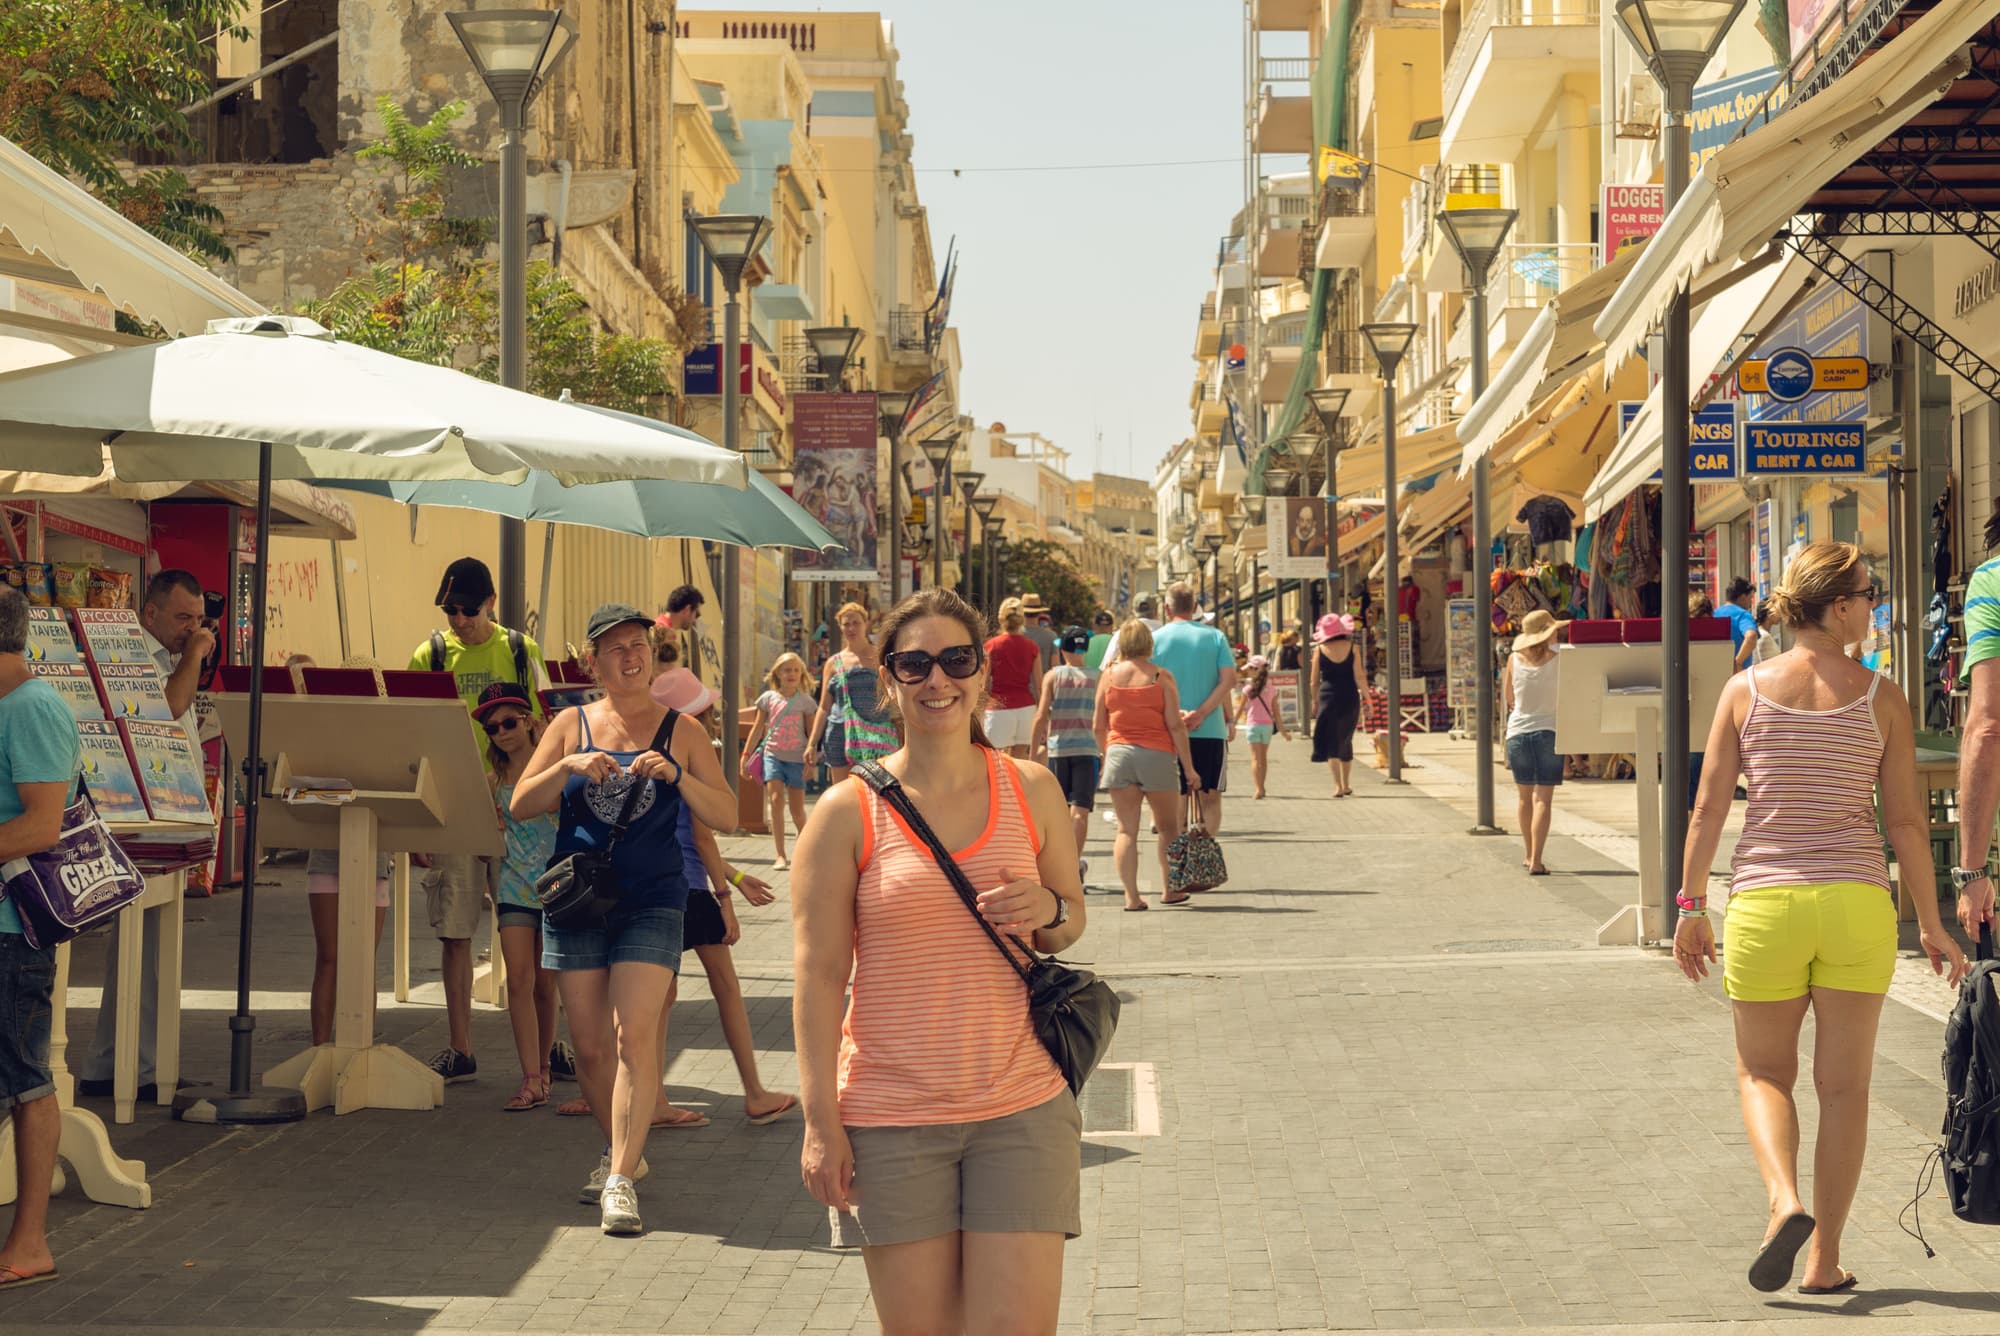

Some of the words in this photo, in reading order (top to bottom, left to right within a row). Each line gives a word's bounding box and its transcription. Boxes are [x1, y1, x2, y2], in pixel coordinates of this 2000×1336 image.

[1684, 80, 1790, 134] www.touri
[1611, 214, 1637, 223] CAR
[1640, 214, 1664, 223] REN
[1693, 424, 1733, 440] NGS
[1751, 430, 1860, 448] TOURINGS
[1694, 454, 1729, 470] CAR
[1757, 455, 1800, 468] RENT
[1805, 455, 1816, 467] A
[1821, 454, 1855, 467] CAR
[29, 609, 49, 619] ANO
[32, 624, 68, 638] TAVERN
[93, 639, 111, 650] FISH
[112, 639, 145, 650] TAVERN
[31, 665, 70, 675] POLSKI
[102, 665, 143, 676] HOLLAND
[58, 681, 92, 691] TAVERN
[108, 681, 126, 691] FISH
[127, 681, 161, 691] TAVERN
[78, 722, 102, 733] NCE
[129, 722, 172, 737] DEUTSCHE
[83, 738, 121, 750] TAVERN
[134, 738, 155, 748] FISH
